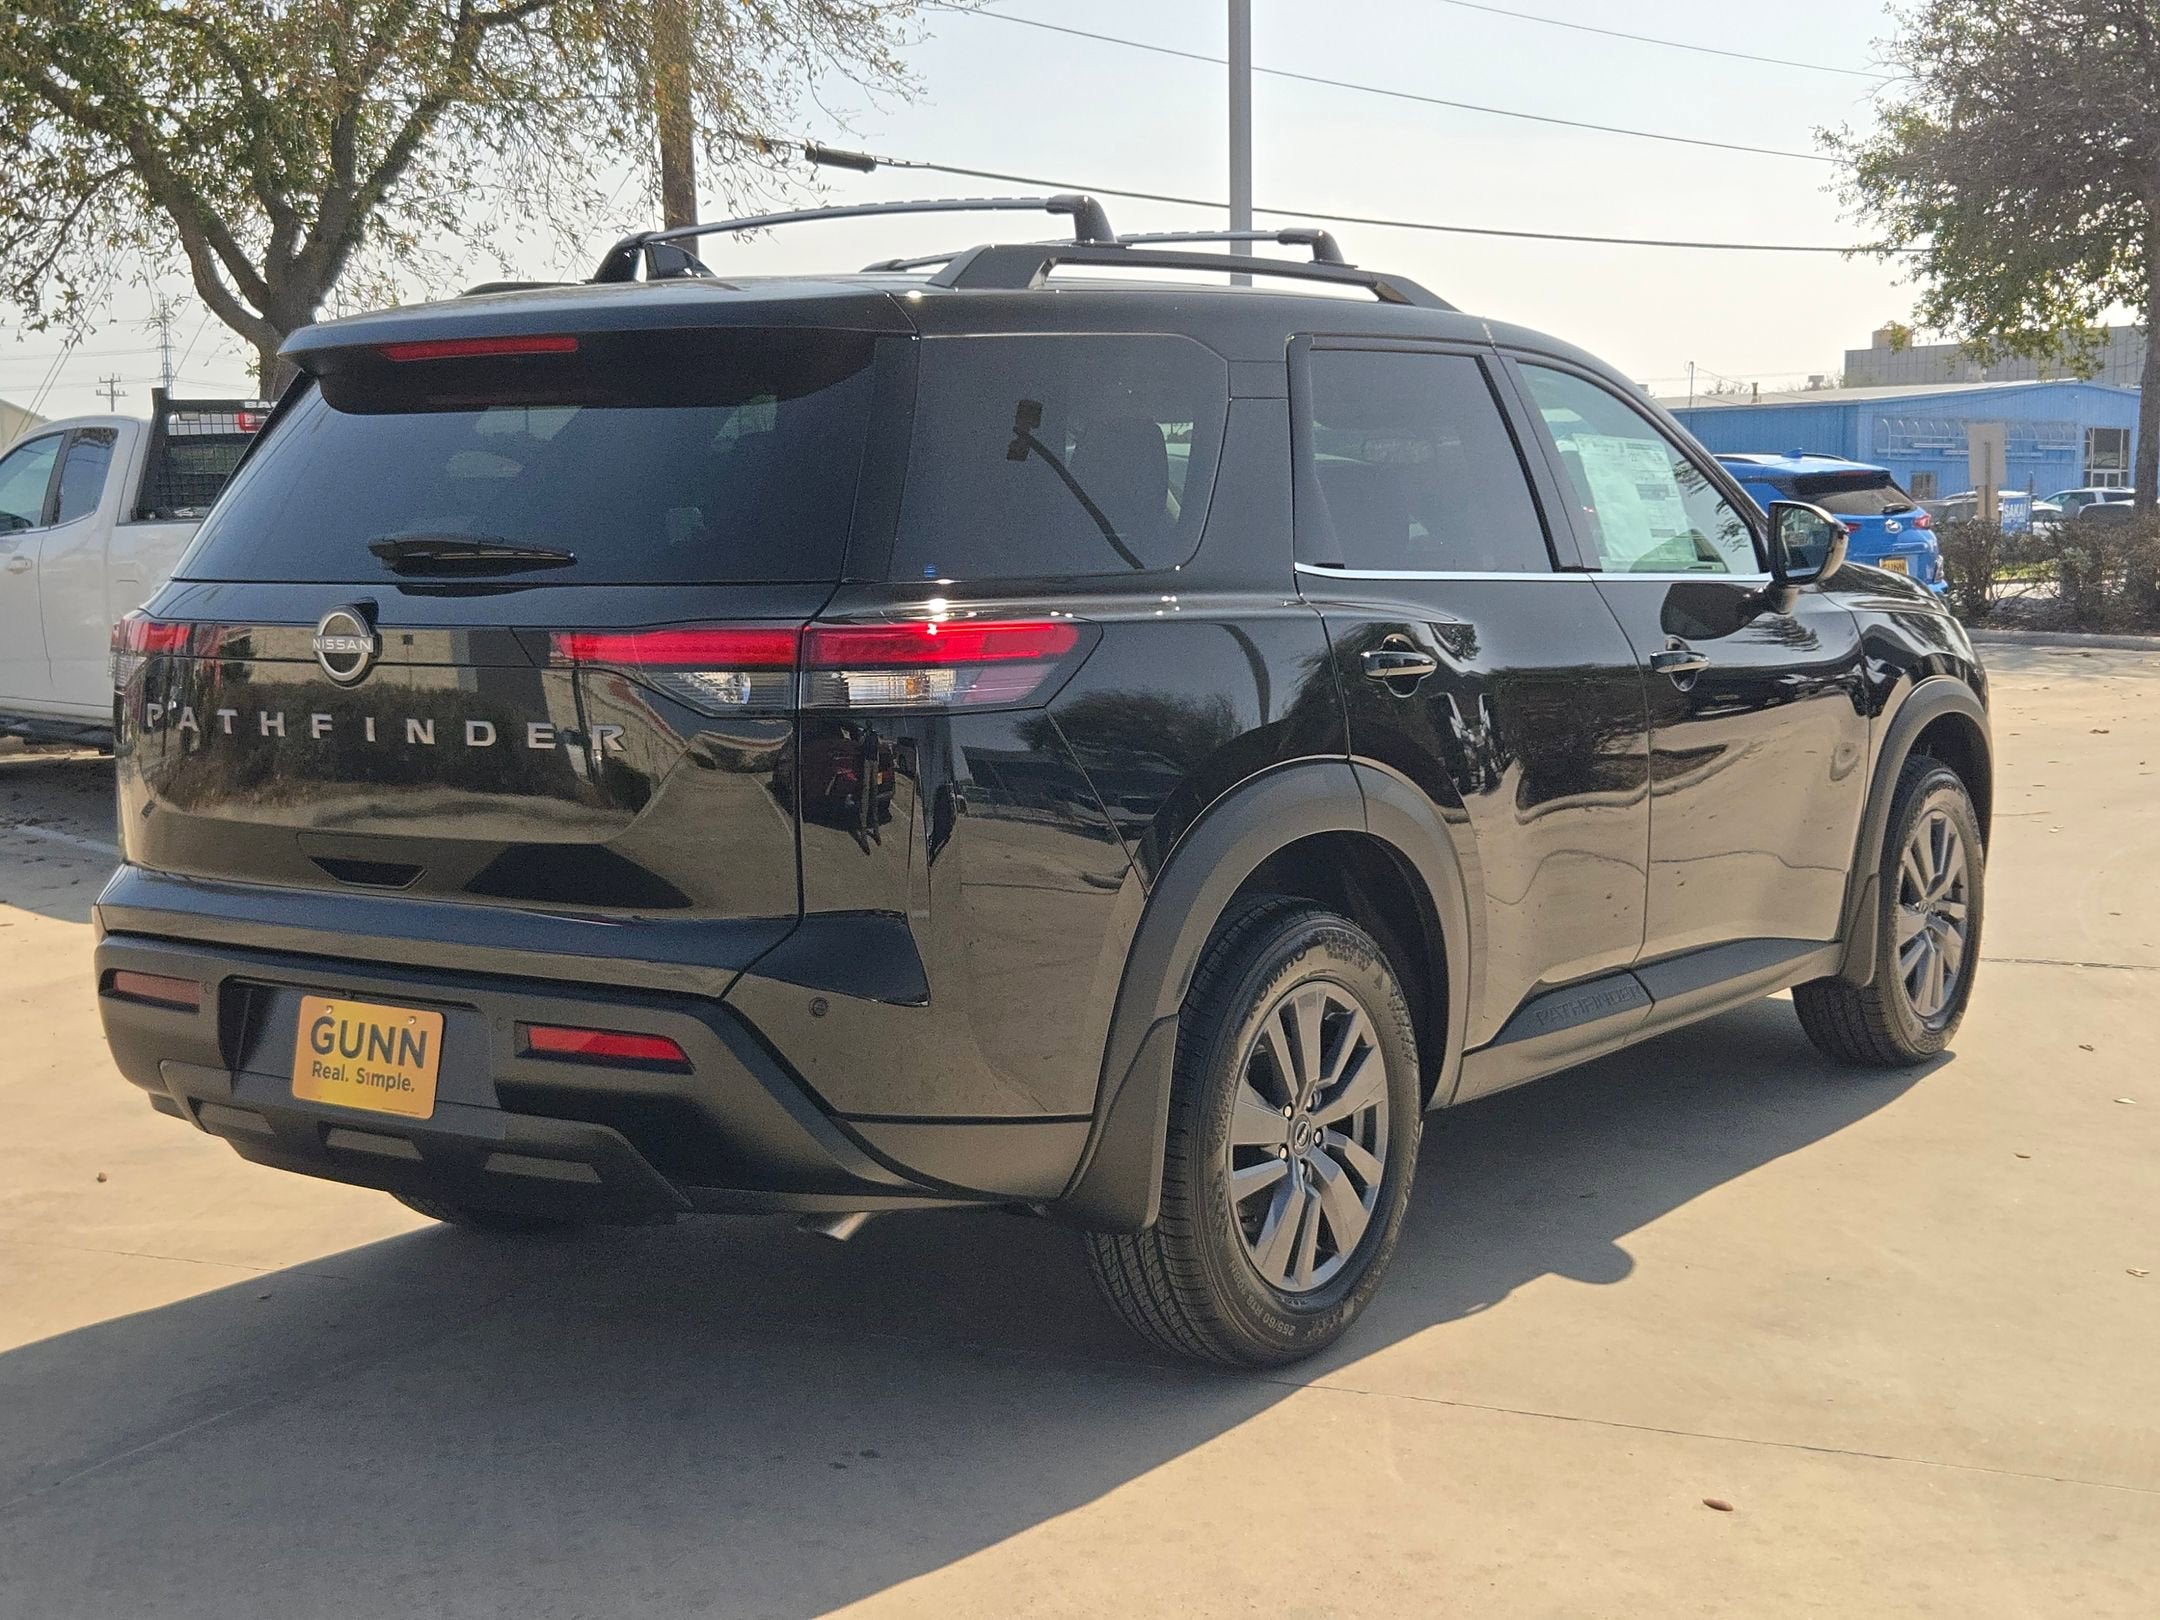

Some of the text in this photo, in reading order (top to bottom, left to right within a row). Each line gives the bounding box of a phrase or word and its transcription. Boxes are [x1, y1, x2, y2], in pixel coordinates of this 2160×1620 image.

[312, 638, 371, 650] NISSAN
[145, 702, 626, 752] PATHFINDER
[310, 1015, 428, 1069] GUNN
[311, 1060, 349, 1083] Real.
